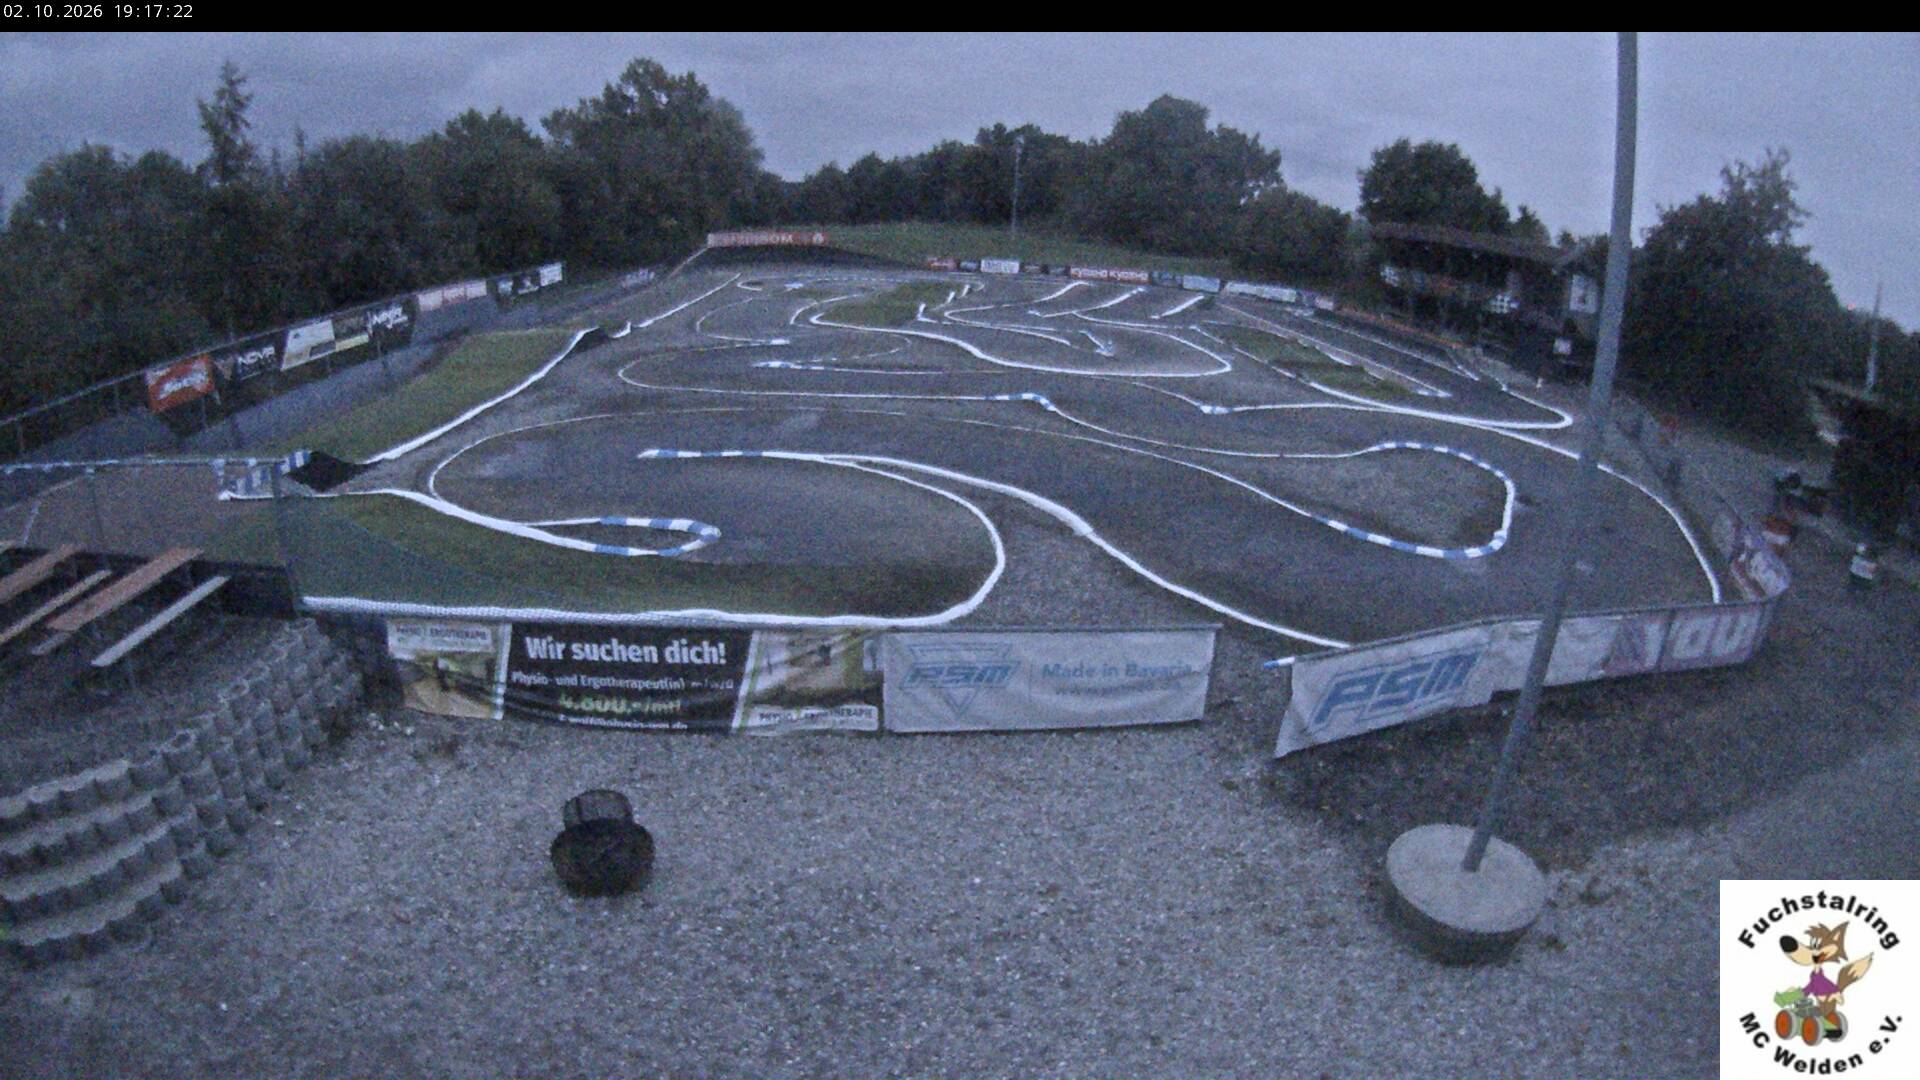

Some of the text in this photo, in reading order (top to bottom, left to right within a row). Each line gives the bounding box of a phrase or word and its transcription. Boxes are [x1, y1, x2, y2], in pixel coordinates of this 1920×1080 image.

[525, 635, 727, 664] Wir suchen dich!
[511, 671, 553, 686] Physio-
[555, 674, 578, 686] und
[580, 674, 685, 691] Ergotherapeut(in)
[1042, 660, 1098, 679] Made
[1101, 662, 1117, 679] in
[1312, 650, 1483, 726] PSM
